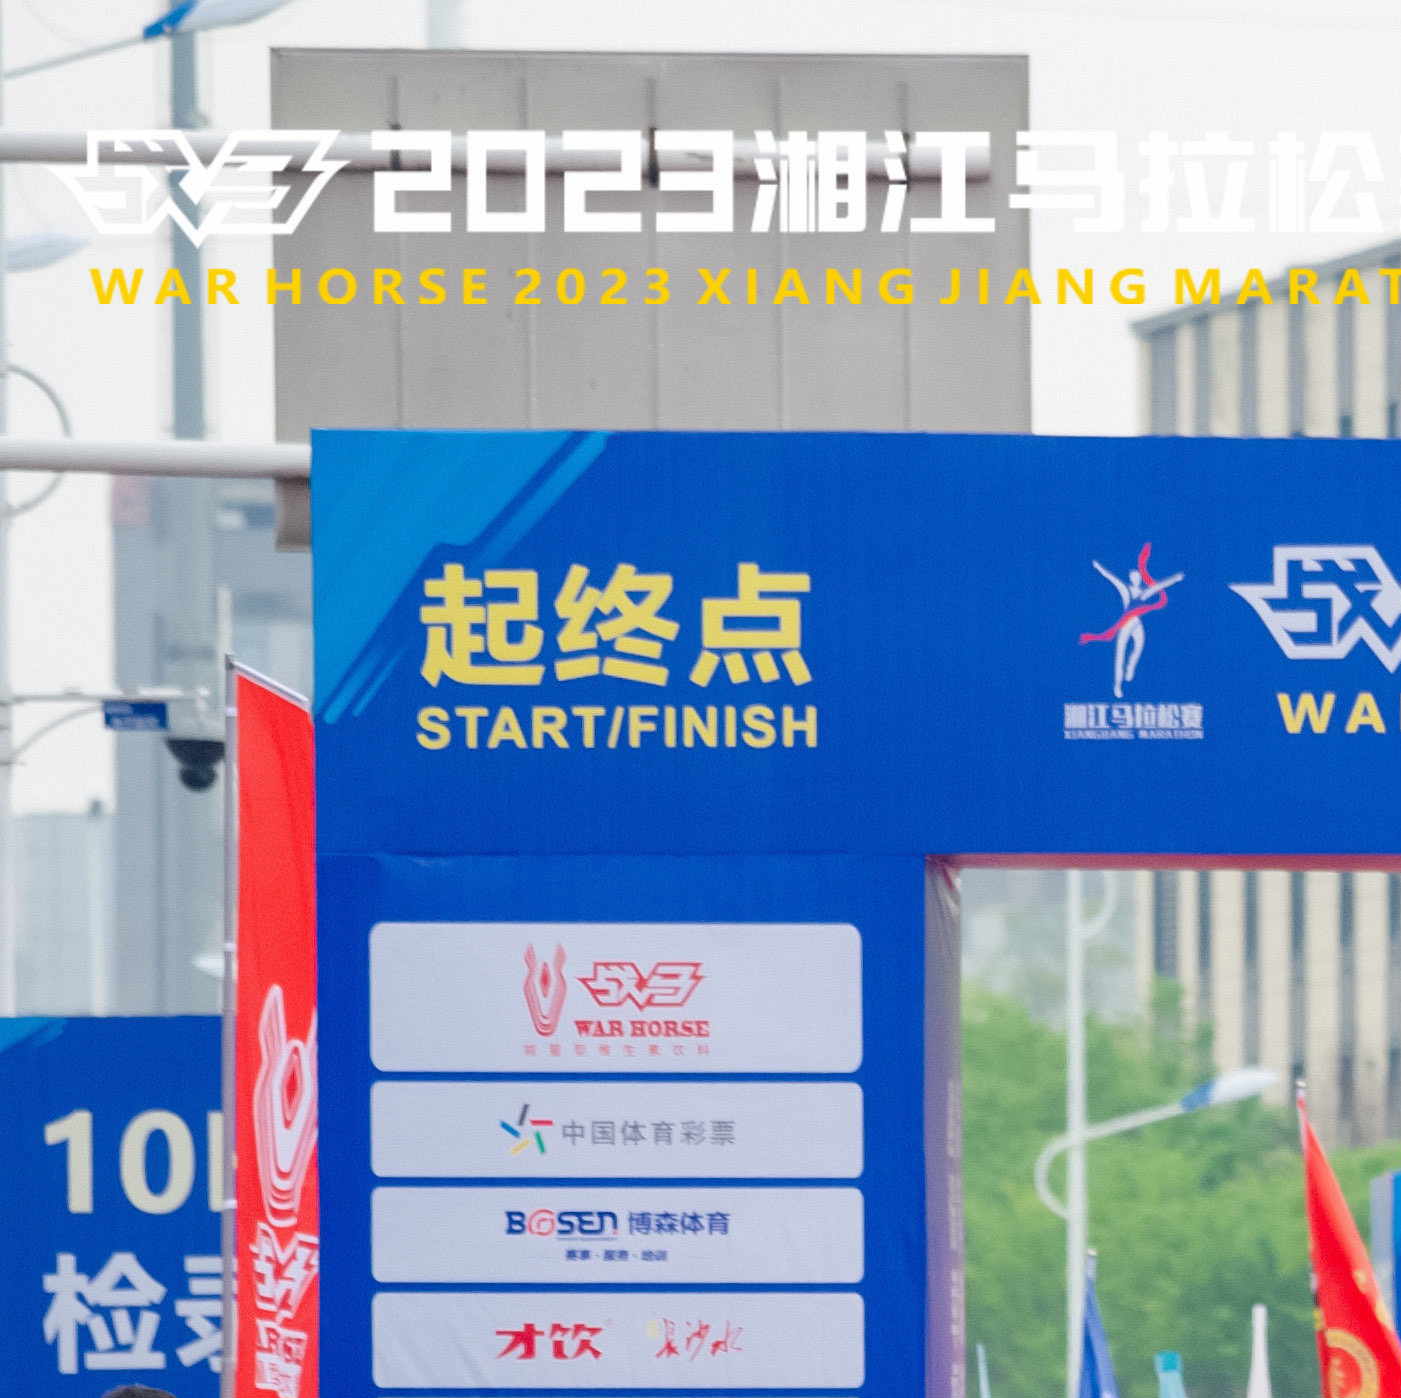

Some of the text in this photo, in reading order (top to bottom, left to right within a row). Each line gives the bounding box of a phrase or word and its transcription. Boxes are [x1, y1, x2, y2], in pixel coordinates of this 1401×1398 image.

[420, 563, 812, 688] 起终点
[416, 705, 818, 750] START/FINISH
[573, 1020, 711, 1039] WAR HORSE
[561, 1119, 737, 1147] 中国体育彩票
[627, 1210, 731, 1236] 博森体育
